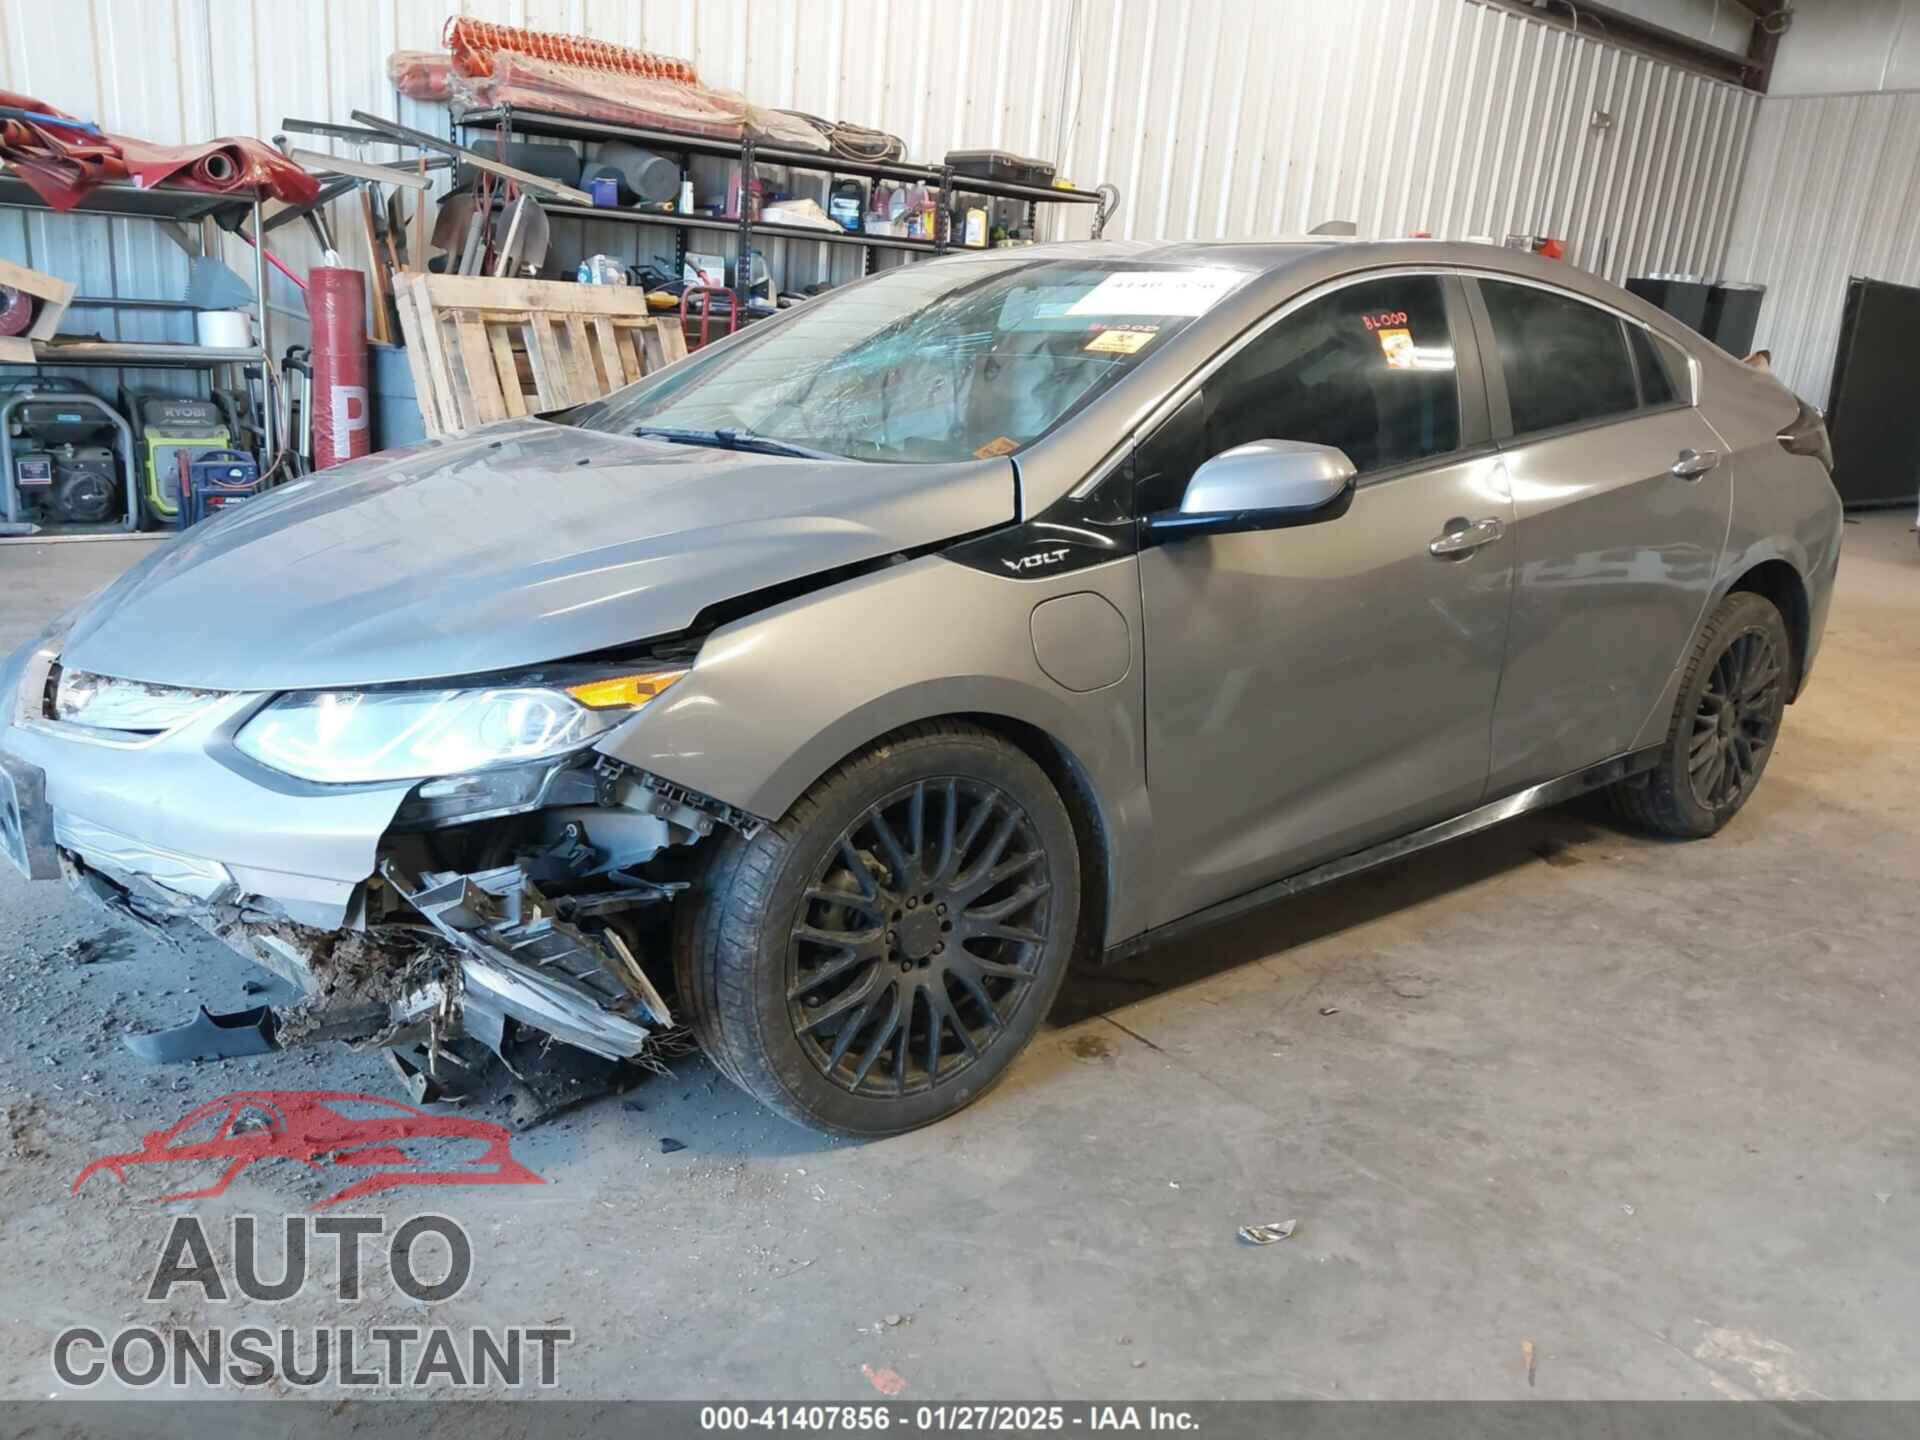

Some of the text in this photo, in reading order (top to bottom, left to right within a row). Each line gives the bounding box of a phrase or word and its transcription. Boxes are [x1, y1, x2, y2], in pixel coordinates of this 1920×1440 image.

[1362, 311, 1408, 330] BLOOD
[163, 406, 206, 417] RYOBI
[1001, 548, 1070, 573] VOLT
